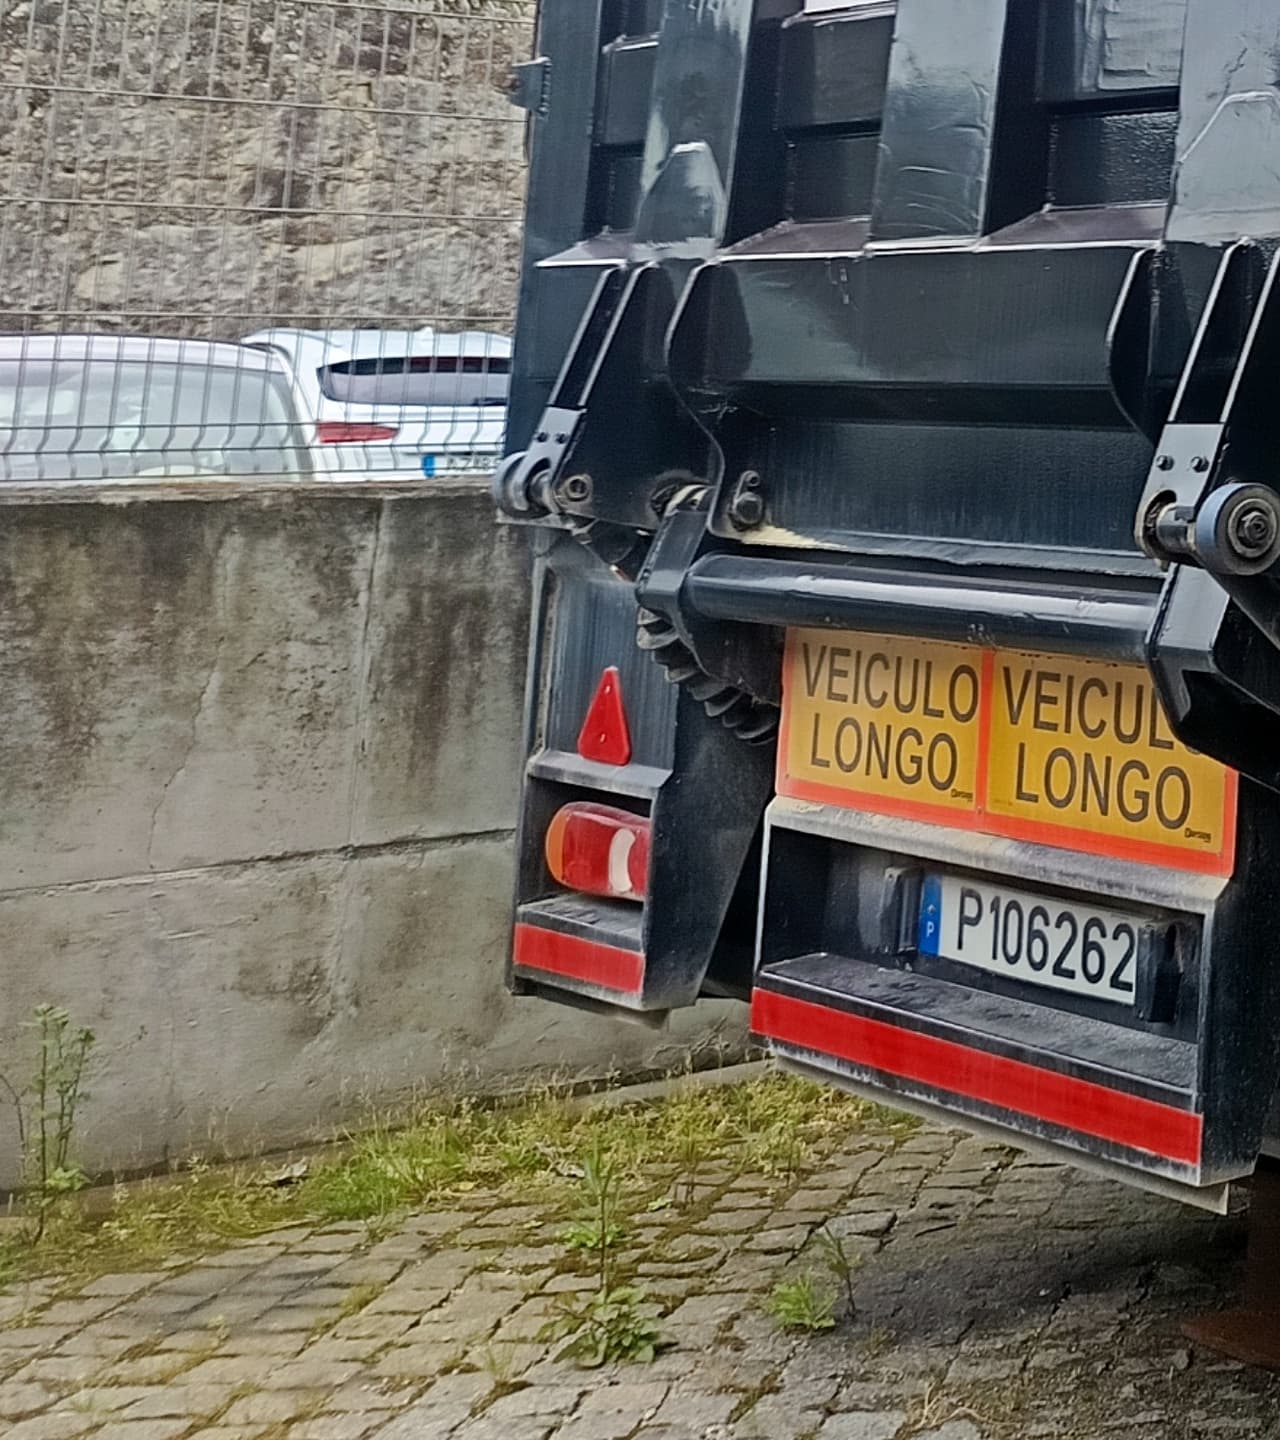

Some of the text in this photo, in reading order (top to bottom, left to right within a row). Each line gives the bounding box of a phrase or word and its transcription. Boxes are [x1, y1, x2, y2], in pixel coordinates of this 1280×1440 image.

[801, 641, 979, 724] VEICULO
[1002, 665, 1201, 756] VEICUL
[810, 712, 958, 792] LONGO
[1015, 741, 1192, 831] LONGO
[926, 921, 935, 937] P
[956, 886, 1136, 992] P106262
